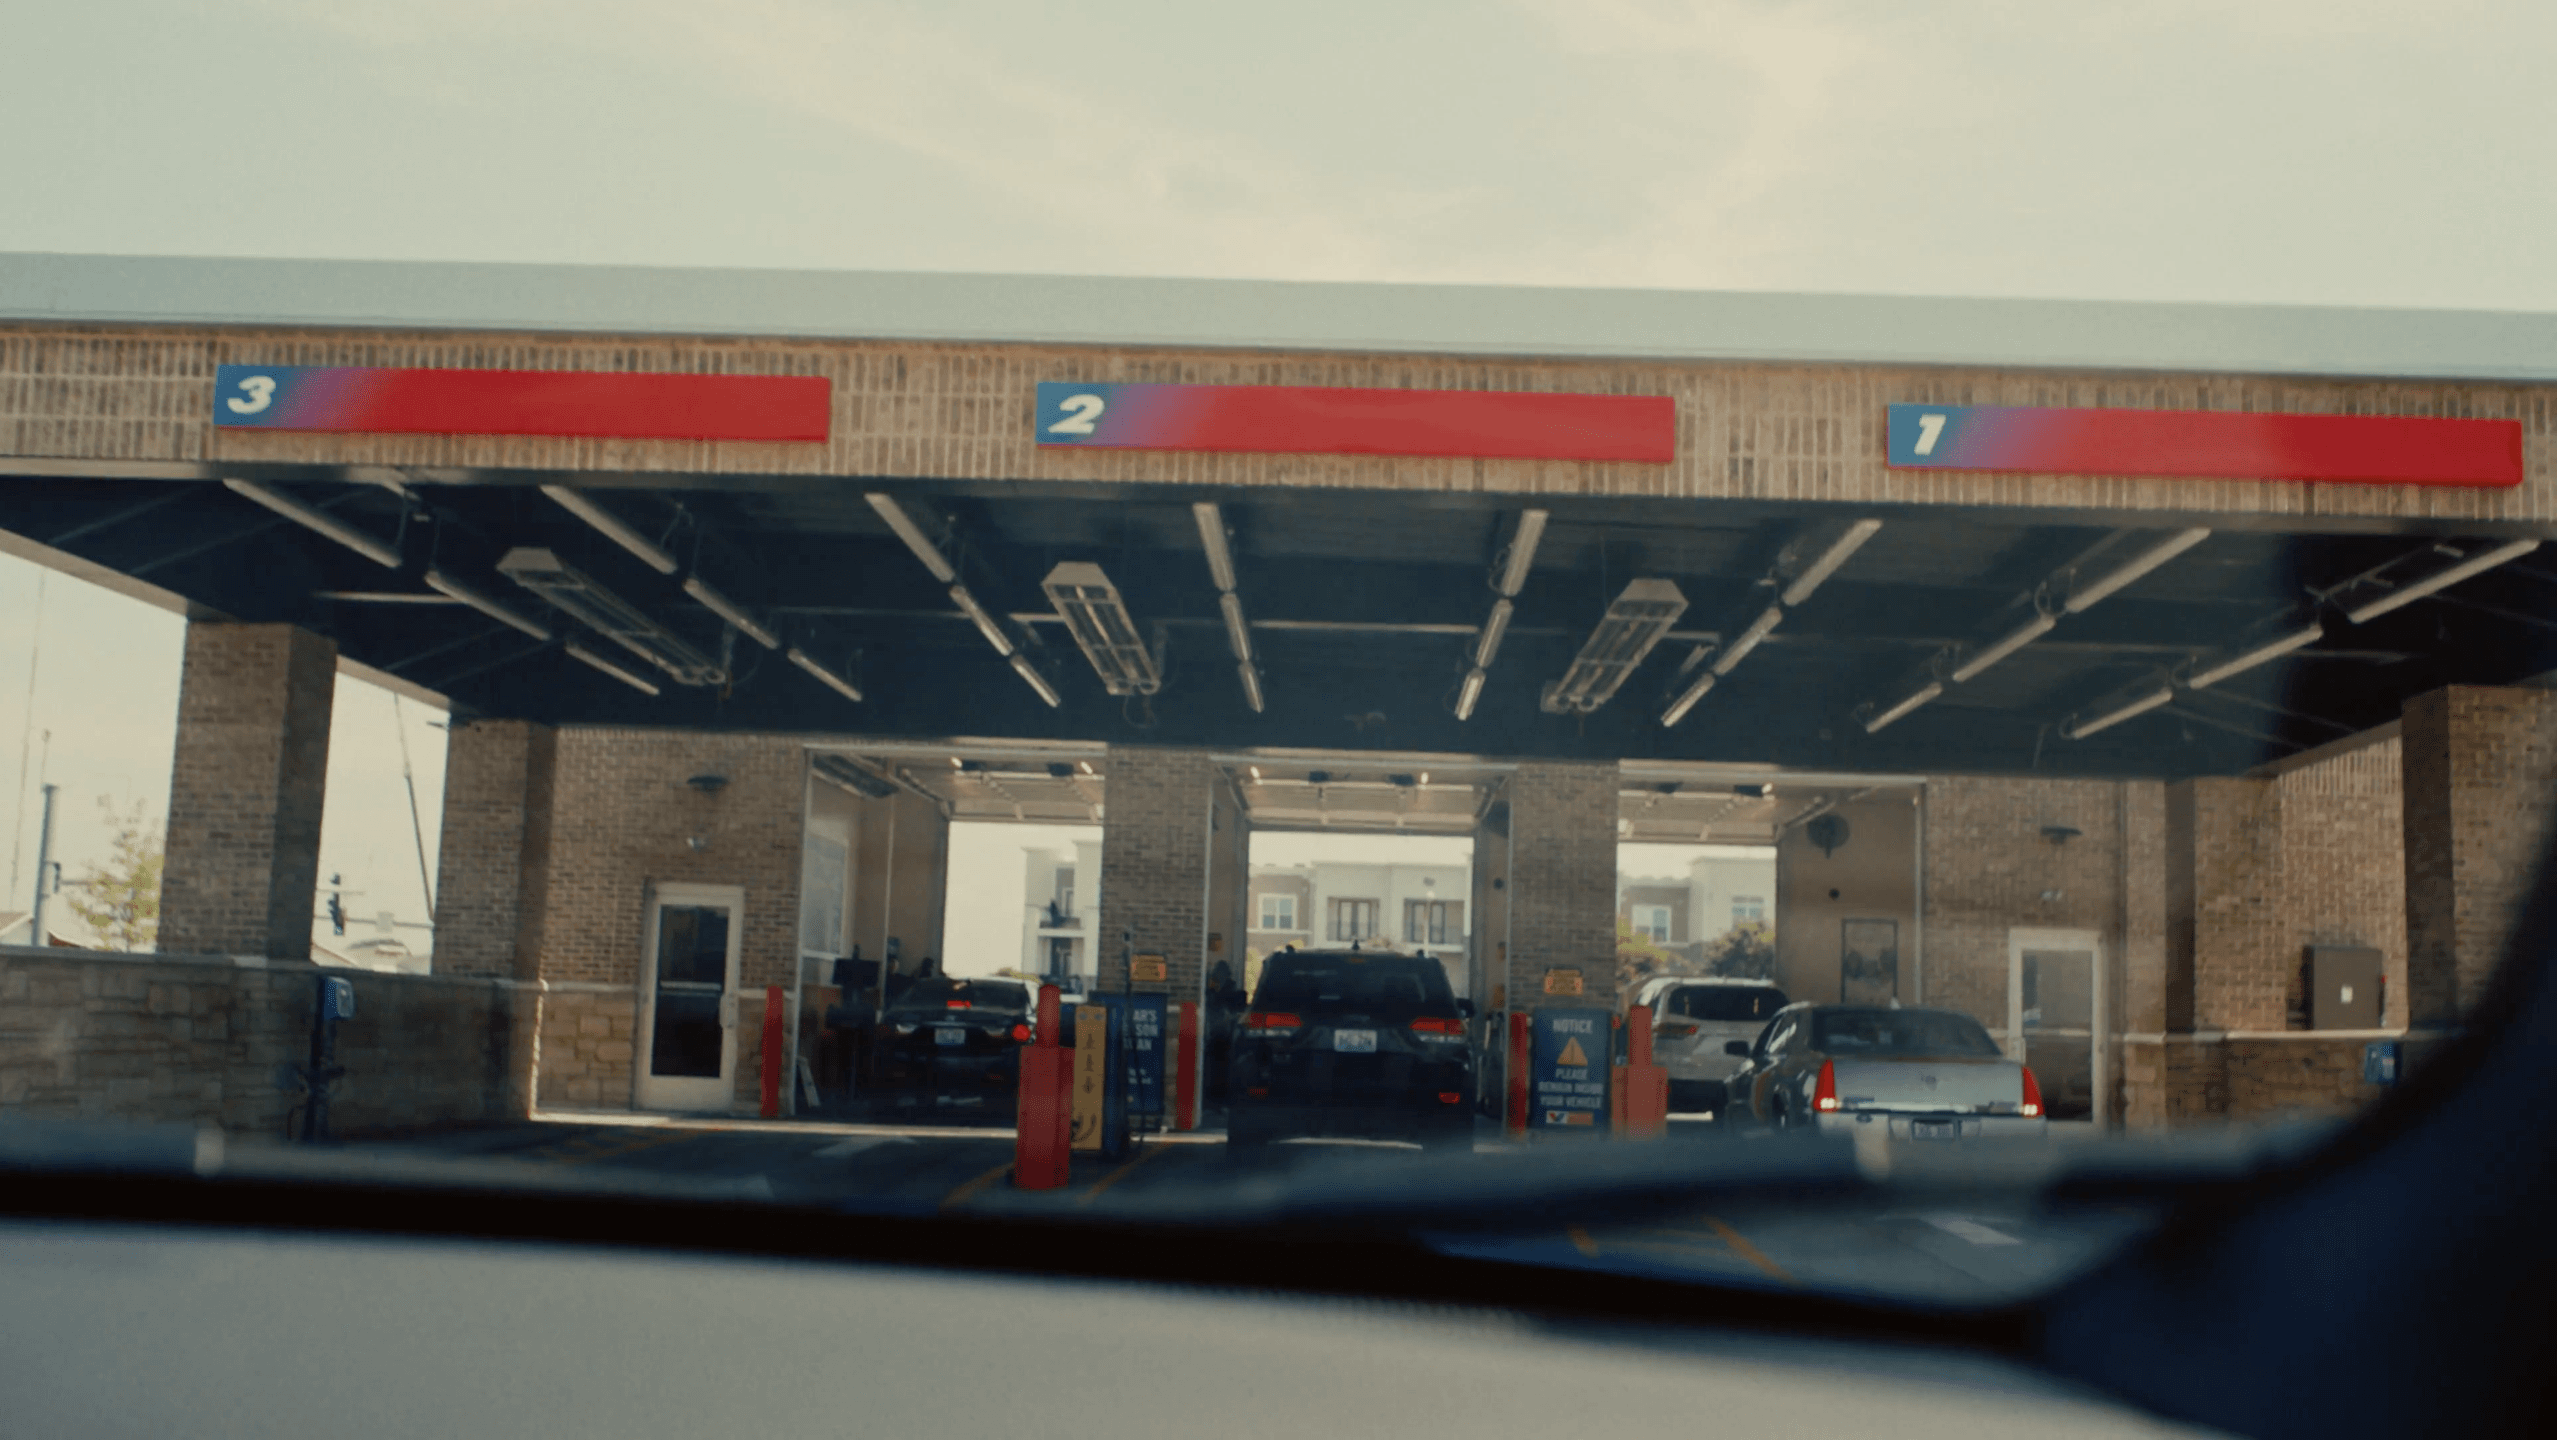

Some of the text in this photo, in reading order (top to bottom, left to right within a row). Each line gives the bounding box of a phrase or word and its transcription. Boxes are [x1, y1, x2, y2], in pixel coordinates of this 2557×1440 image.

[227, 375, 276, 414] 3
[1047, 393, 1105, 435] 2
[1914, 414, 1947, 455] 1
[1552, 1018, 1593, 1034] NOTICE
[1555, 1067, 1588, 1080] PLEASE
[1540, 1095, 1602, 1109] YOUR VEHICLE
